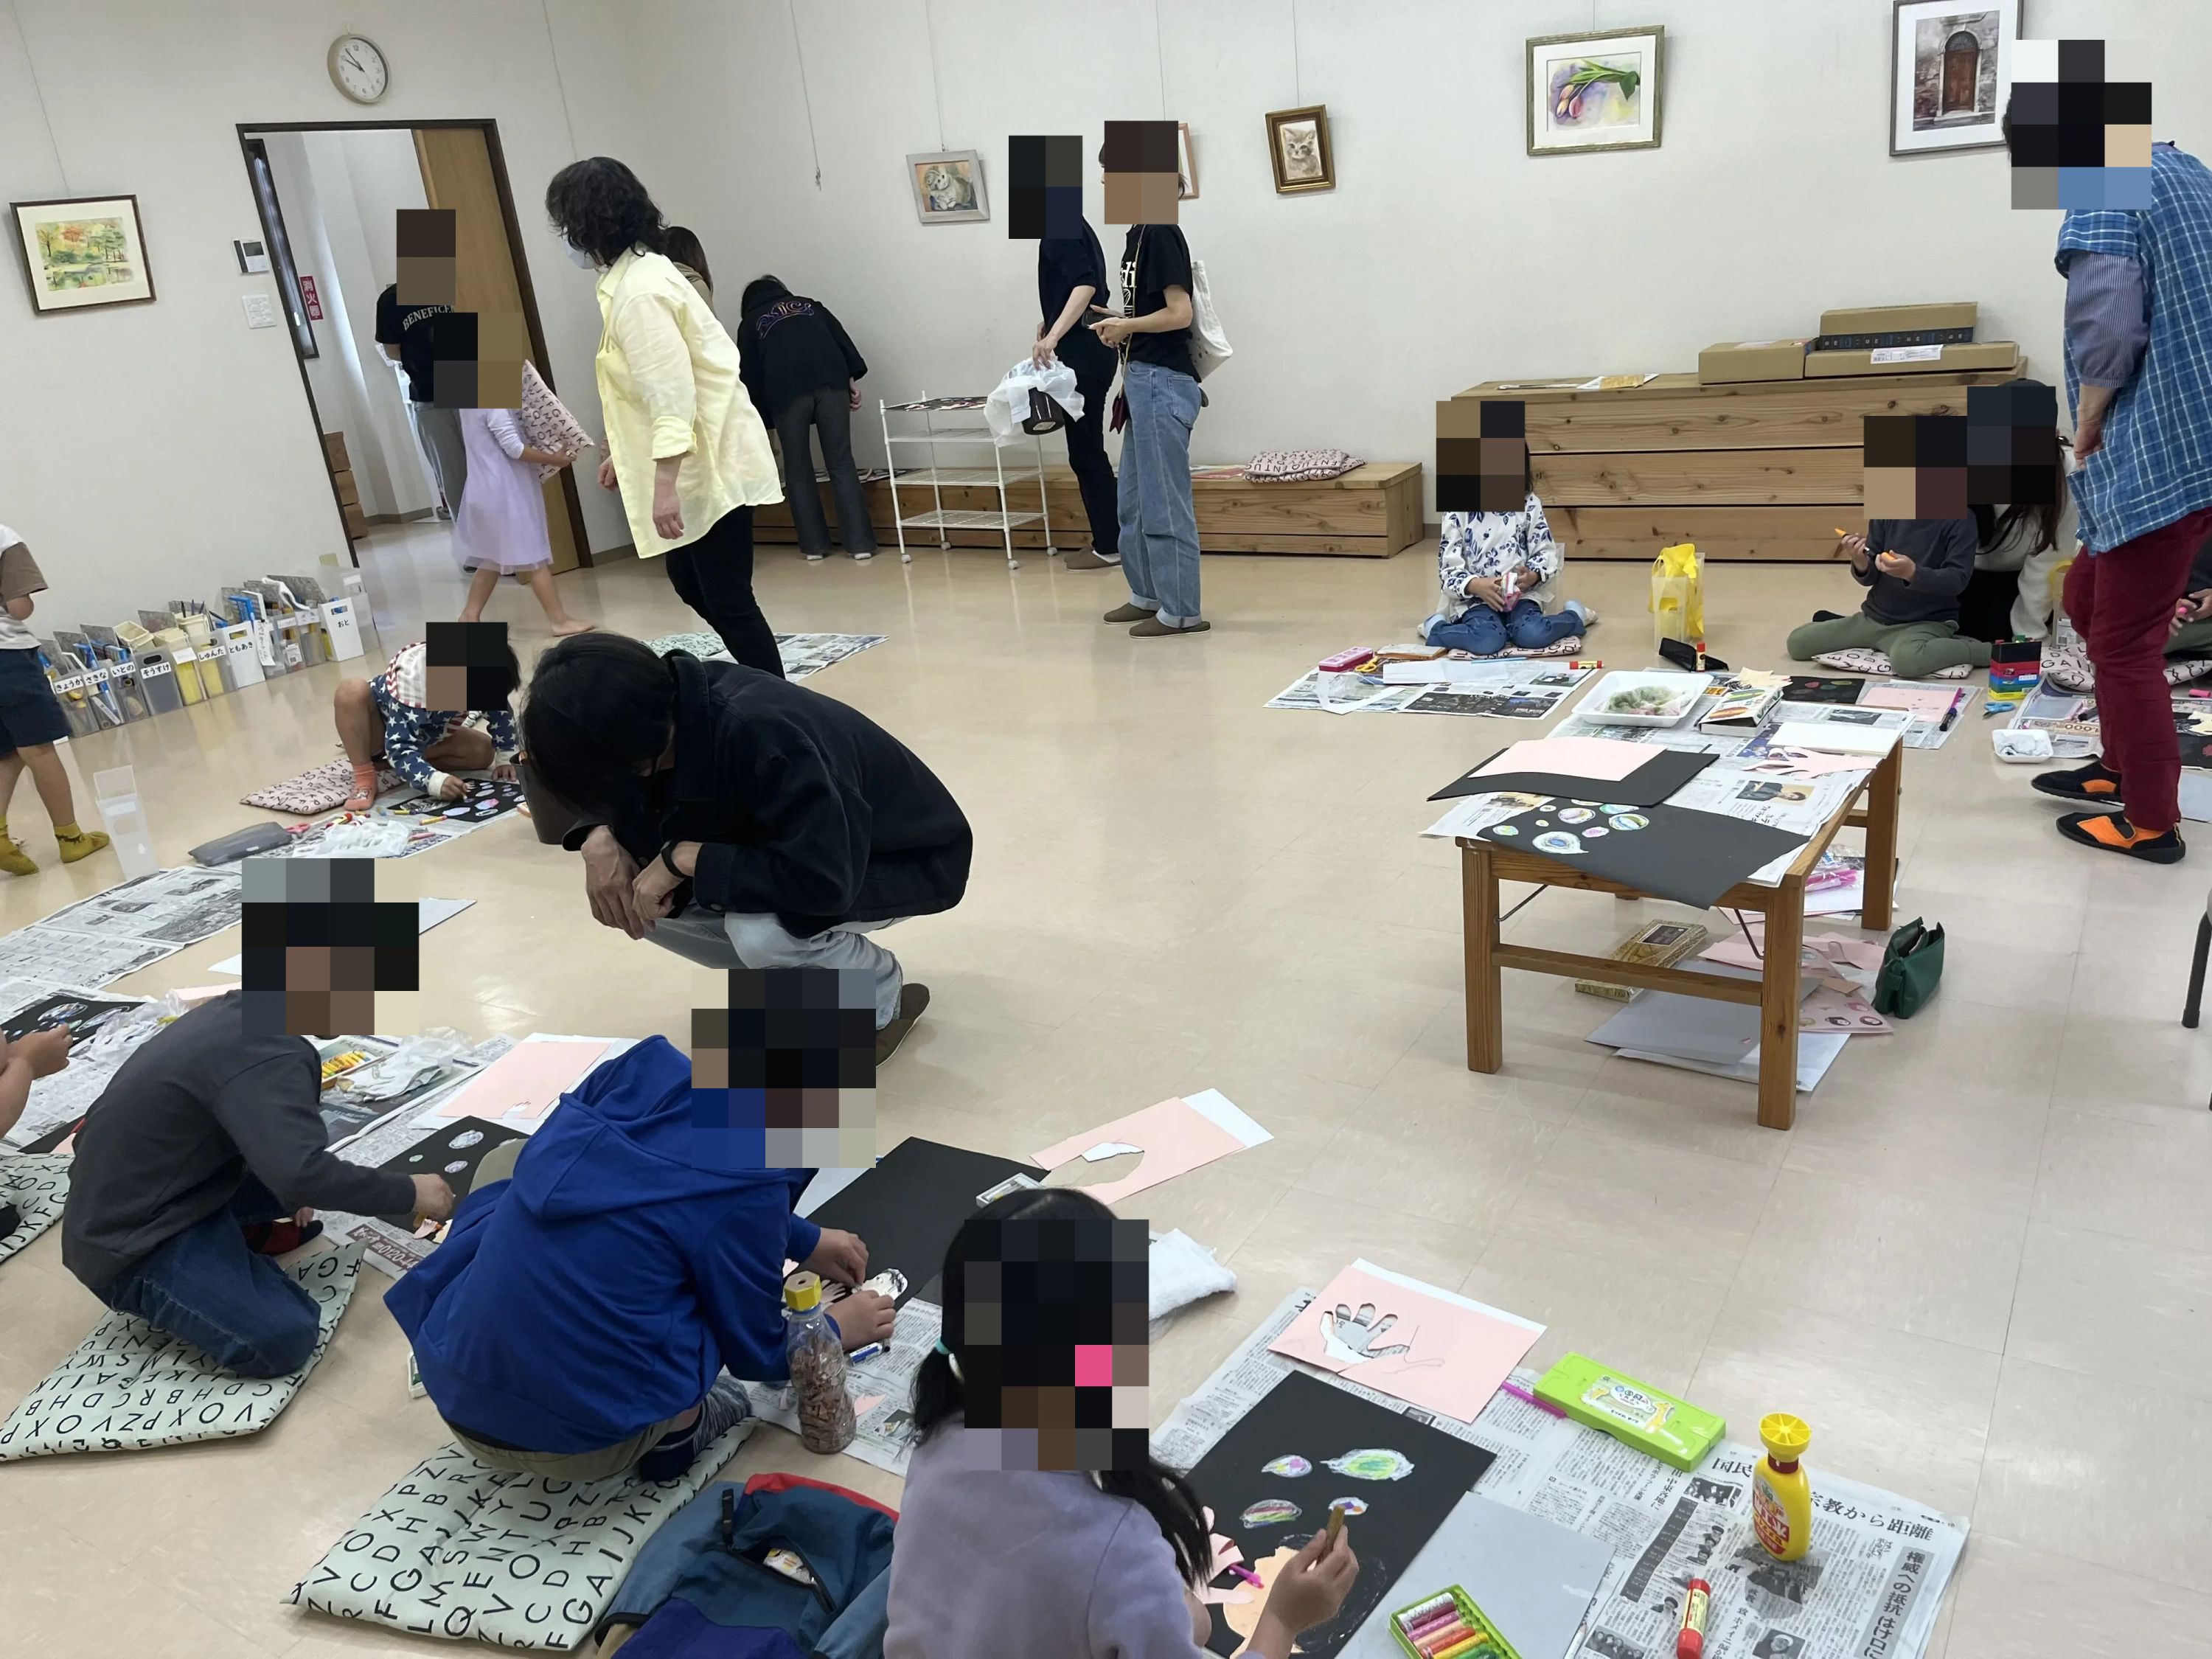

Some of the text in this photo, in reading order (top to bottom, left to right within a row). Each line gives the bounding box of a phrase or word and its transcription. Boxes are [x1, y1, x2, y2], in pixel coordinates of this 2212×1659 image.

[302, 280, 320, 316] 消火器
[229, 641, 253, 653] ともあき
[198, 648, 224, 660] しゅんた
[112, 665, 134, 675] いとの
[143, 664, 170, 676] そうすけ
[86, 672, 107, 684] さきな
[56, 678, 83, 692] きょうか
[1711, 1457, 1753, 1477] 国民
[1863, 1550, 1926, 1659] 権威への抵抗 はけ口に
